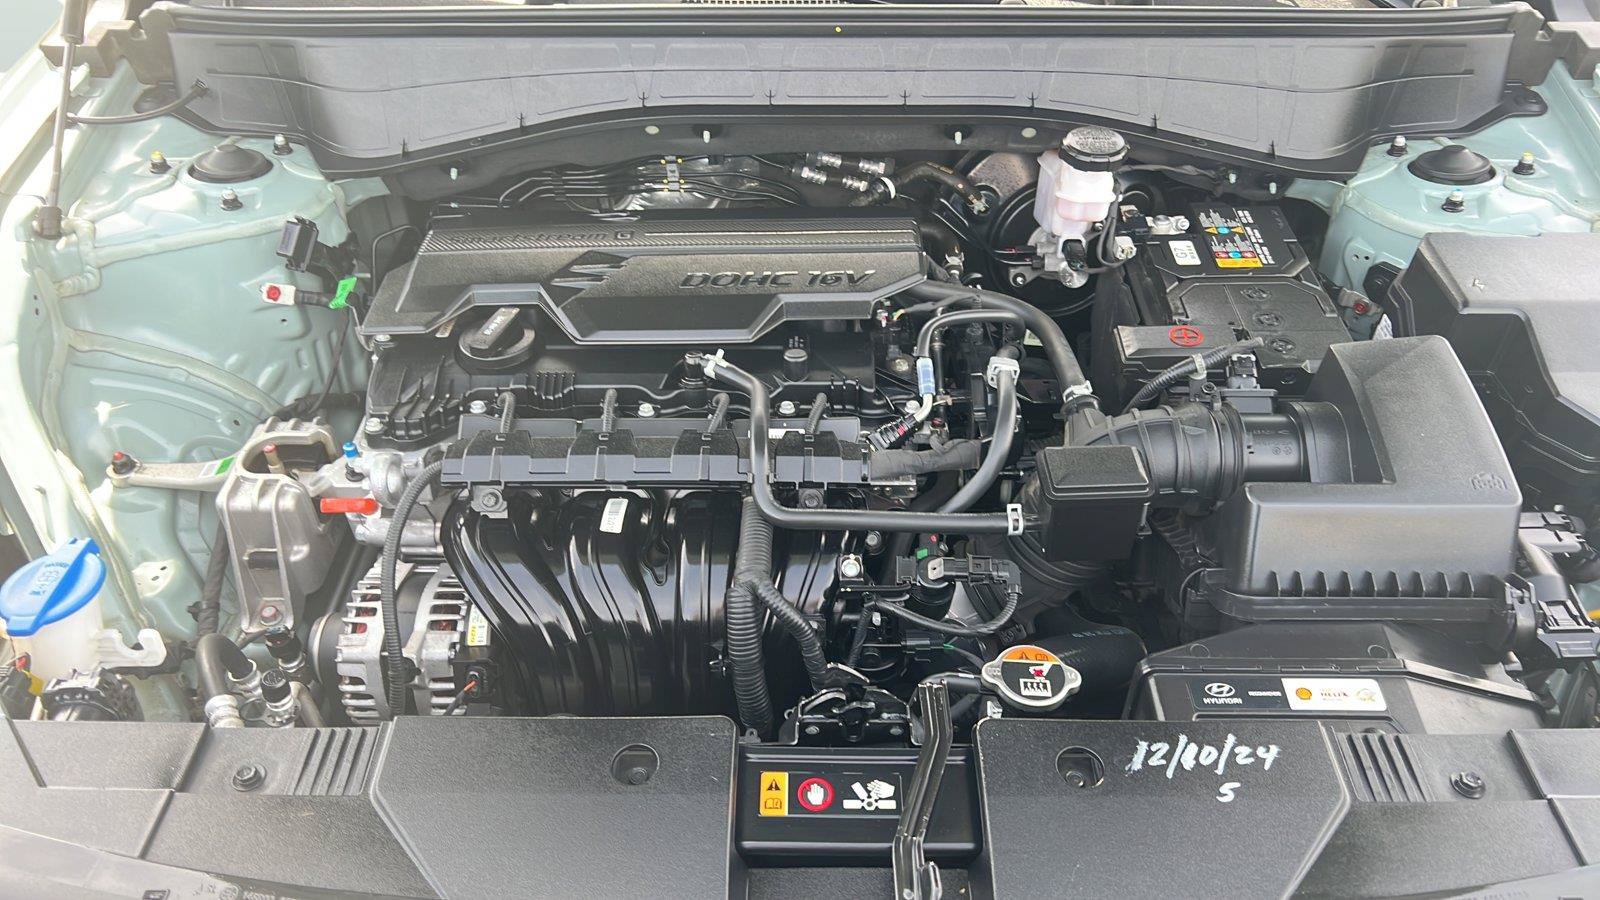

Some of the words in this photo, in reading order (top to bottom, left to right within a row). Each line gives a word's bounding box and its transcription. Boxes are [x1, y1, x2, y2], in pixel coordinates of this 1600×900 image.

[679, 269, 798, 288] DOHC
[807, 269, 875, 287] 16V
[1203, 697, 1242, 705] HYUNDAI
